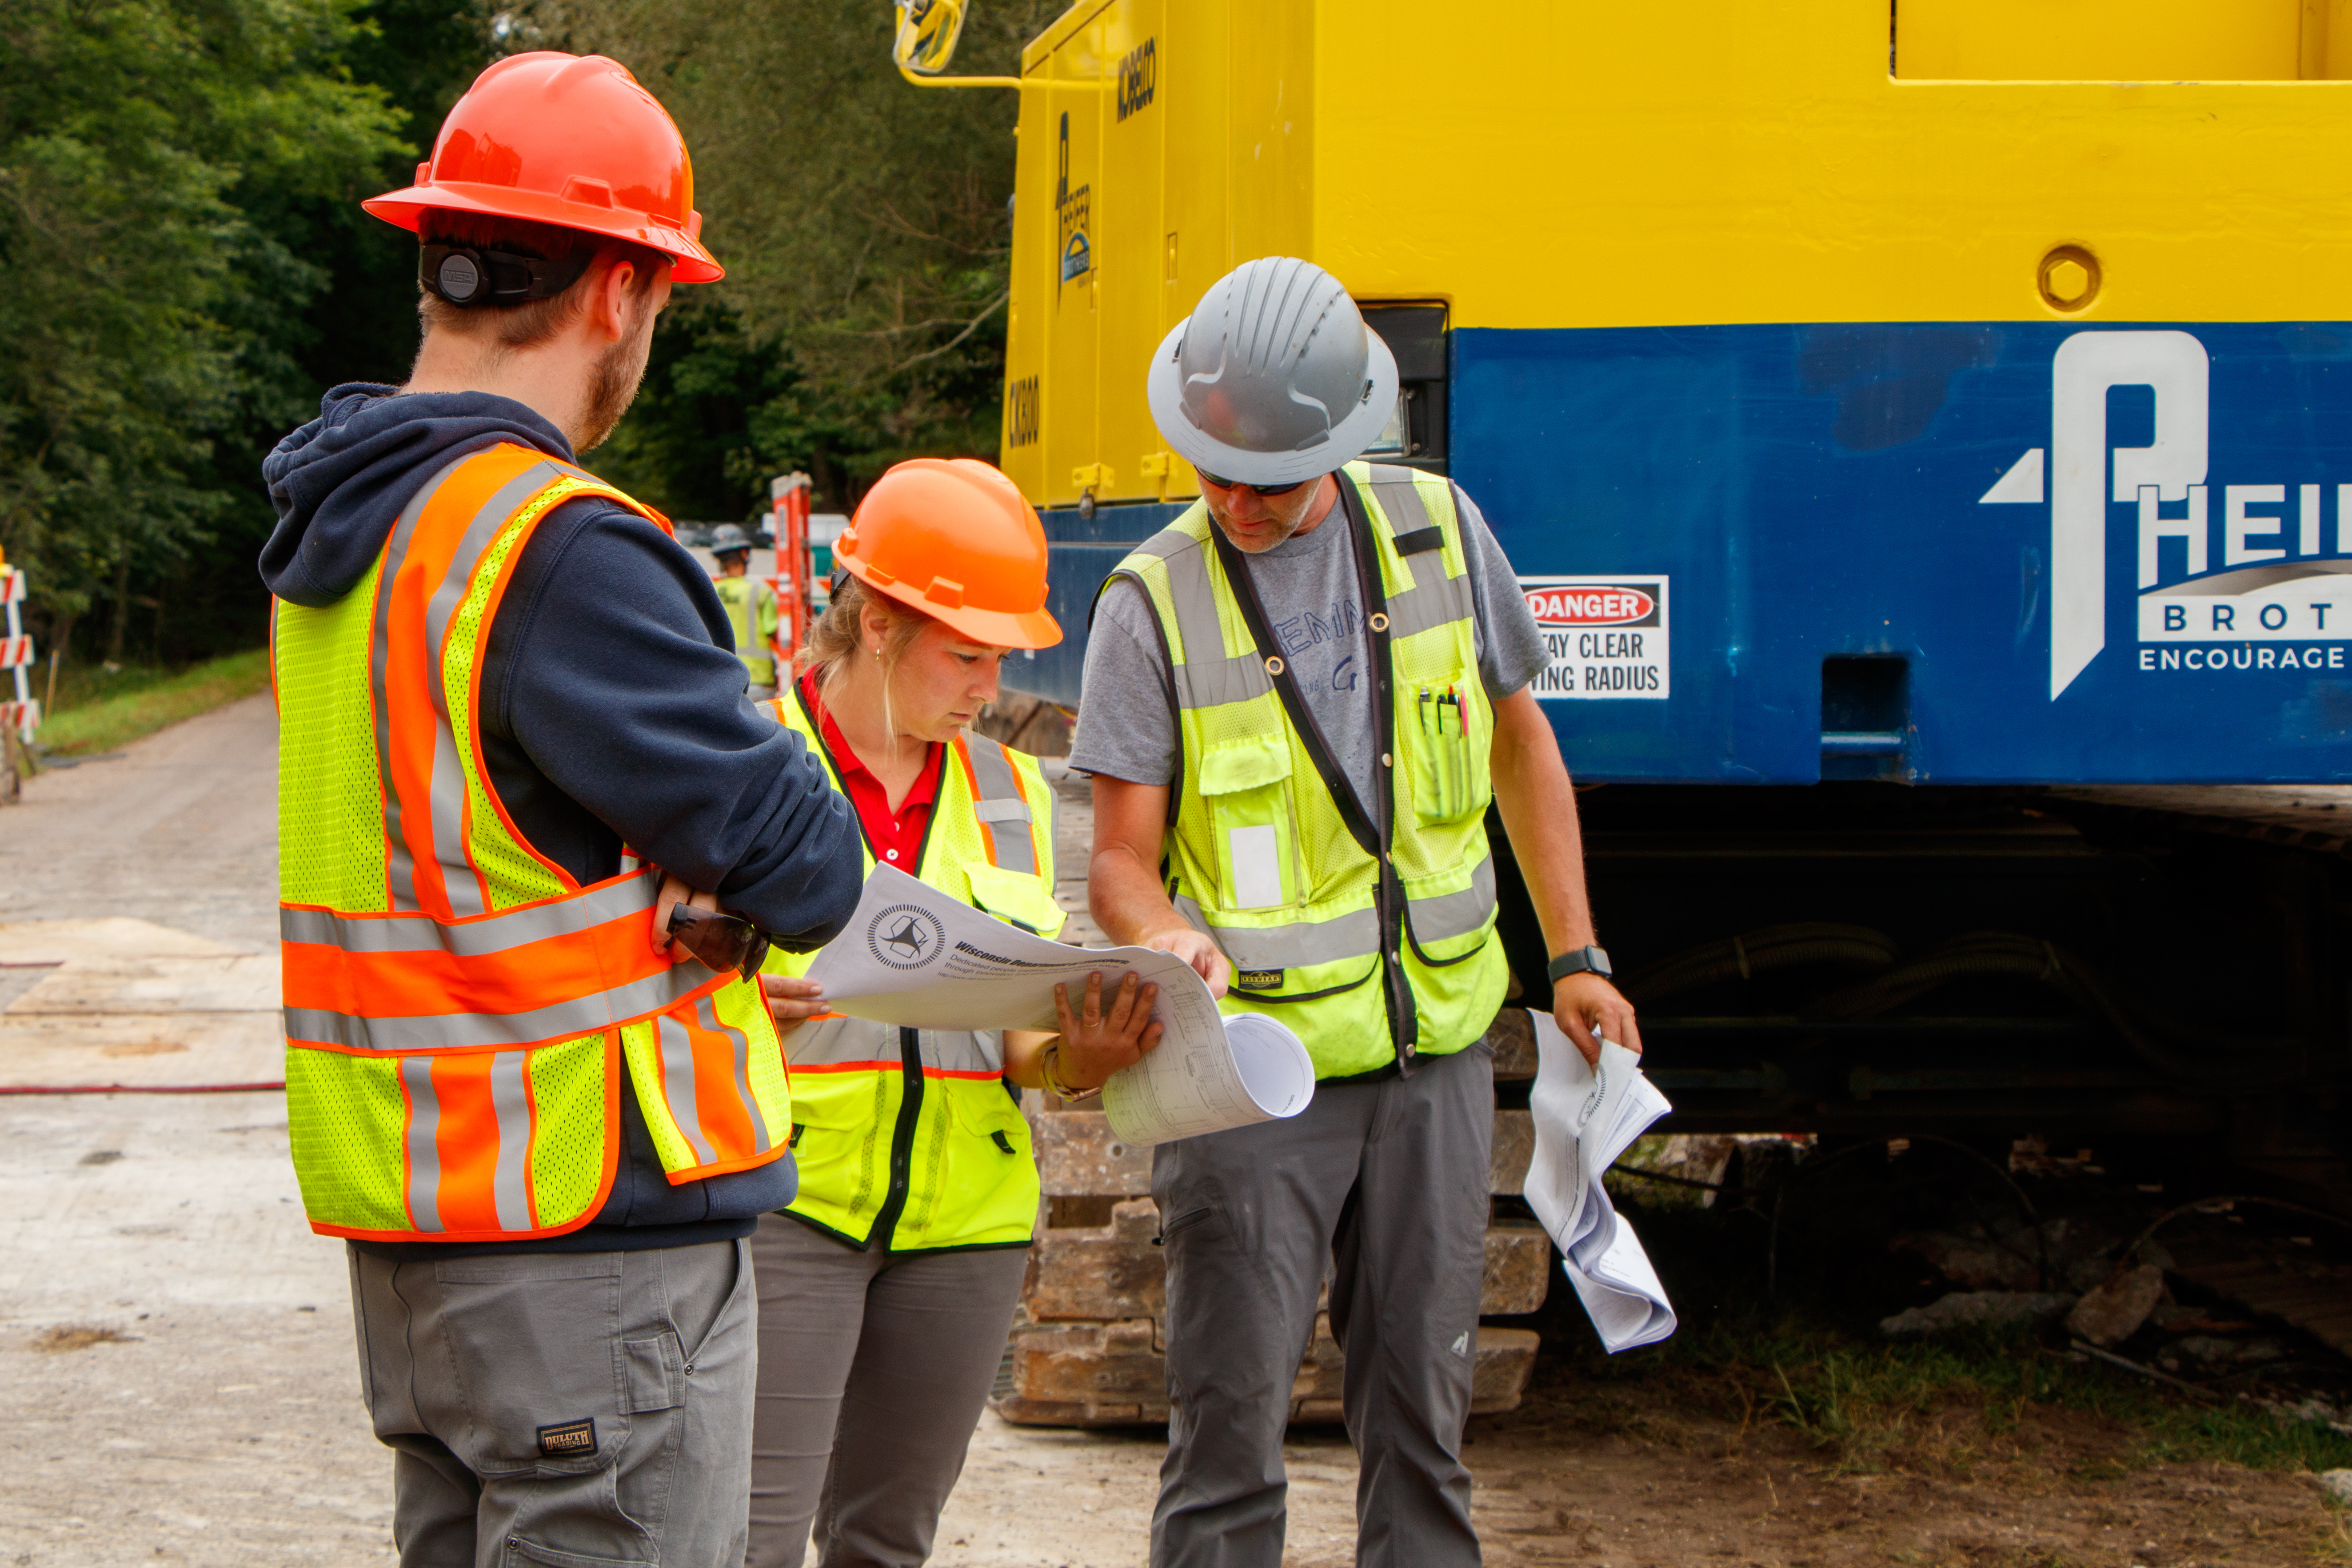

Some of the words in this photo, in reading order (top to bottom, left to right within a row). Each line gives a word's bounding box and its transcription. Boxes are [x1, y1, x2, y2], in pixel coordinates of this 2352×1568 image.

[443, 270, 475, 284] MSA
[1527, 594, 1639, 618] DANGER
[2164, 603, 2332, 631] BROT
[1542, 634, 1569, 658] AY
[1580, 633, 1644, 658] CLEAR
[2139, 647, 2344, 670] ENCOURAGE
[1585, 665, 1659, 690] RADIUS
[950, 954, 990, 970] Dedicated
[954, 941, 1012, 964] Wisconsin
[944, 962, 974, 974] through
[545, 1430, 590, 1450] DULUTH
[554, 1440, 581, 1449] TRADING
